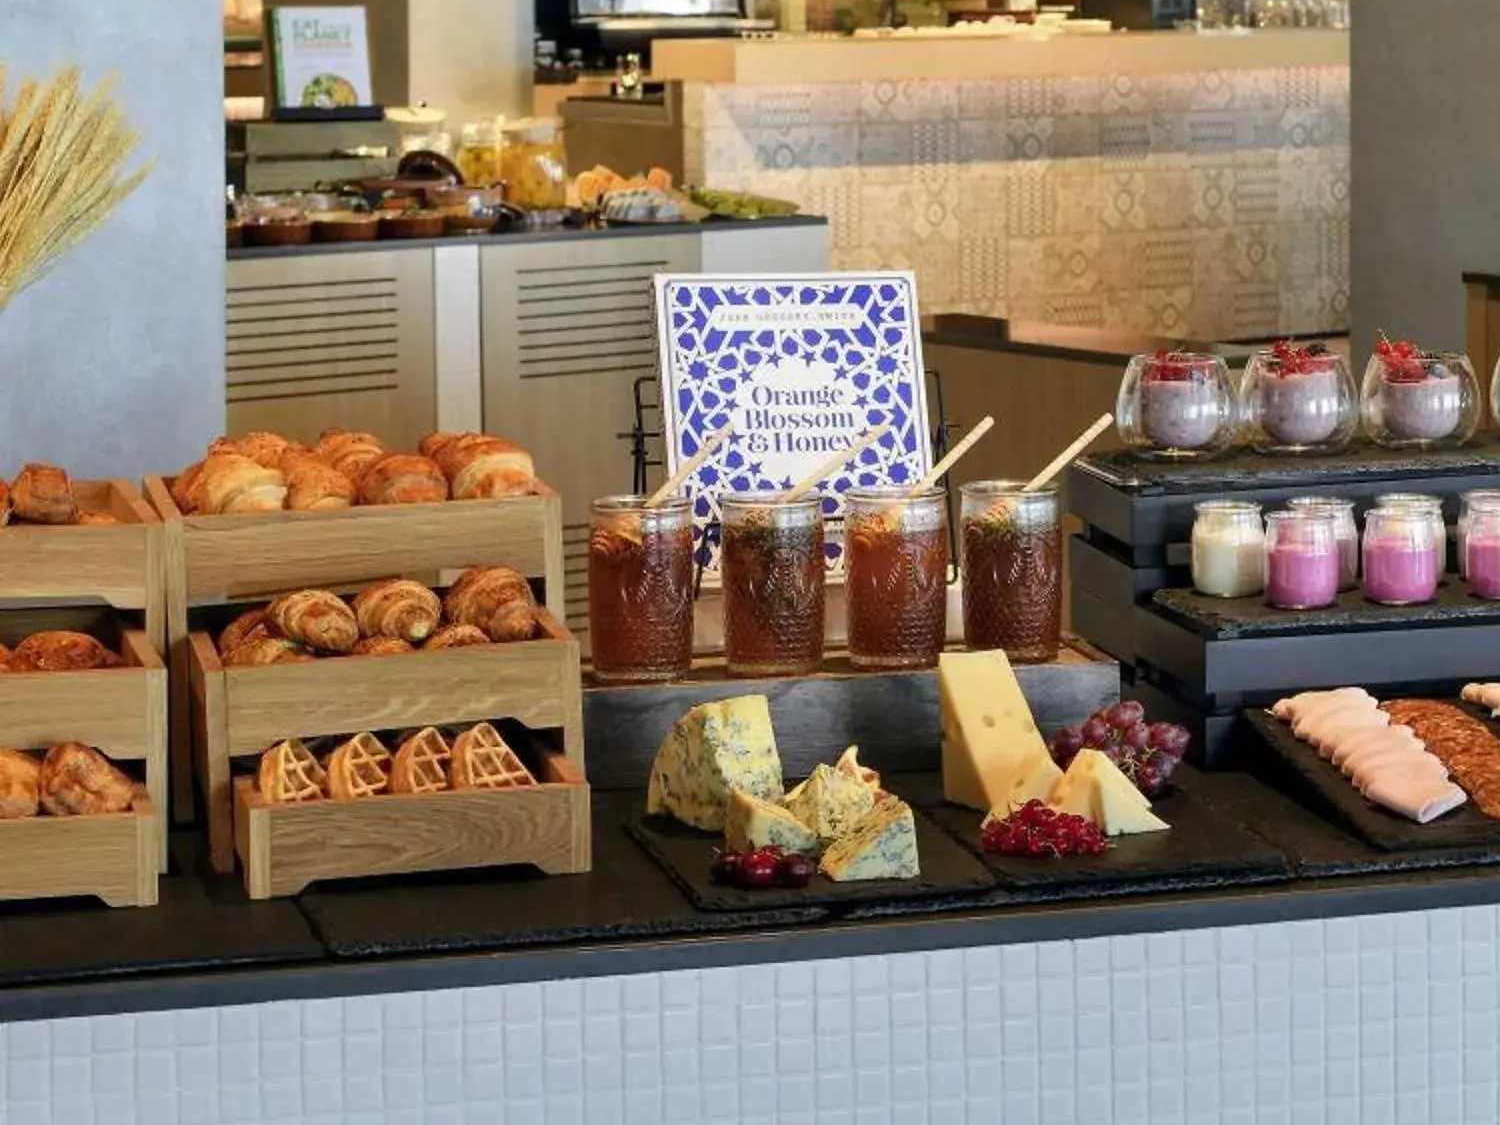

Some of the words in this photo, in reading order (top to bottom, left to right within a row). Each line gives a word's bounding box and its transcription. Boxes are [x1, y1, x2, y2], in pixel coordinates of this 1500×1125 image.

[751, 385, 844, 408] Orange
[745, 408, 855, 430] Blossom
[747, 432, 770, 454] &
